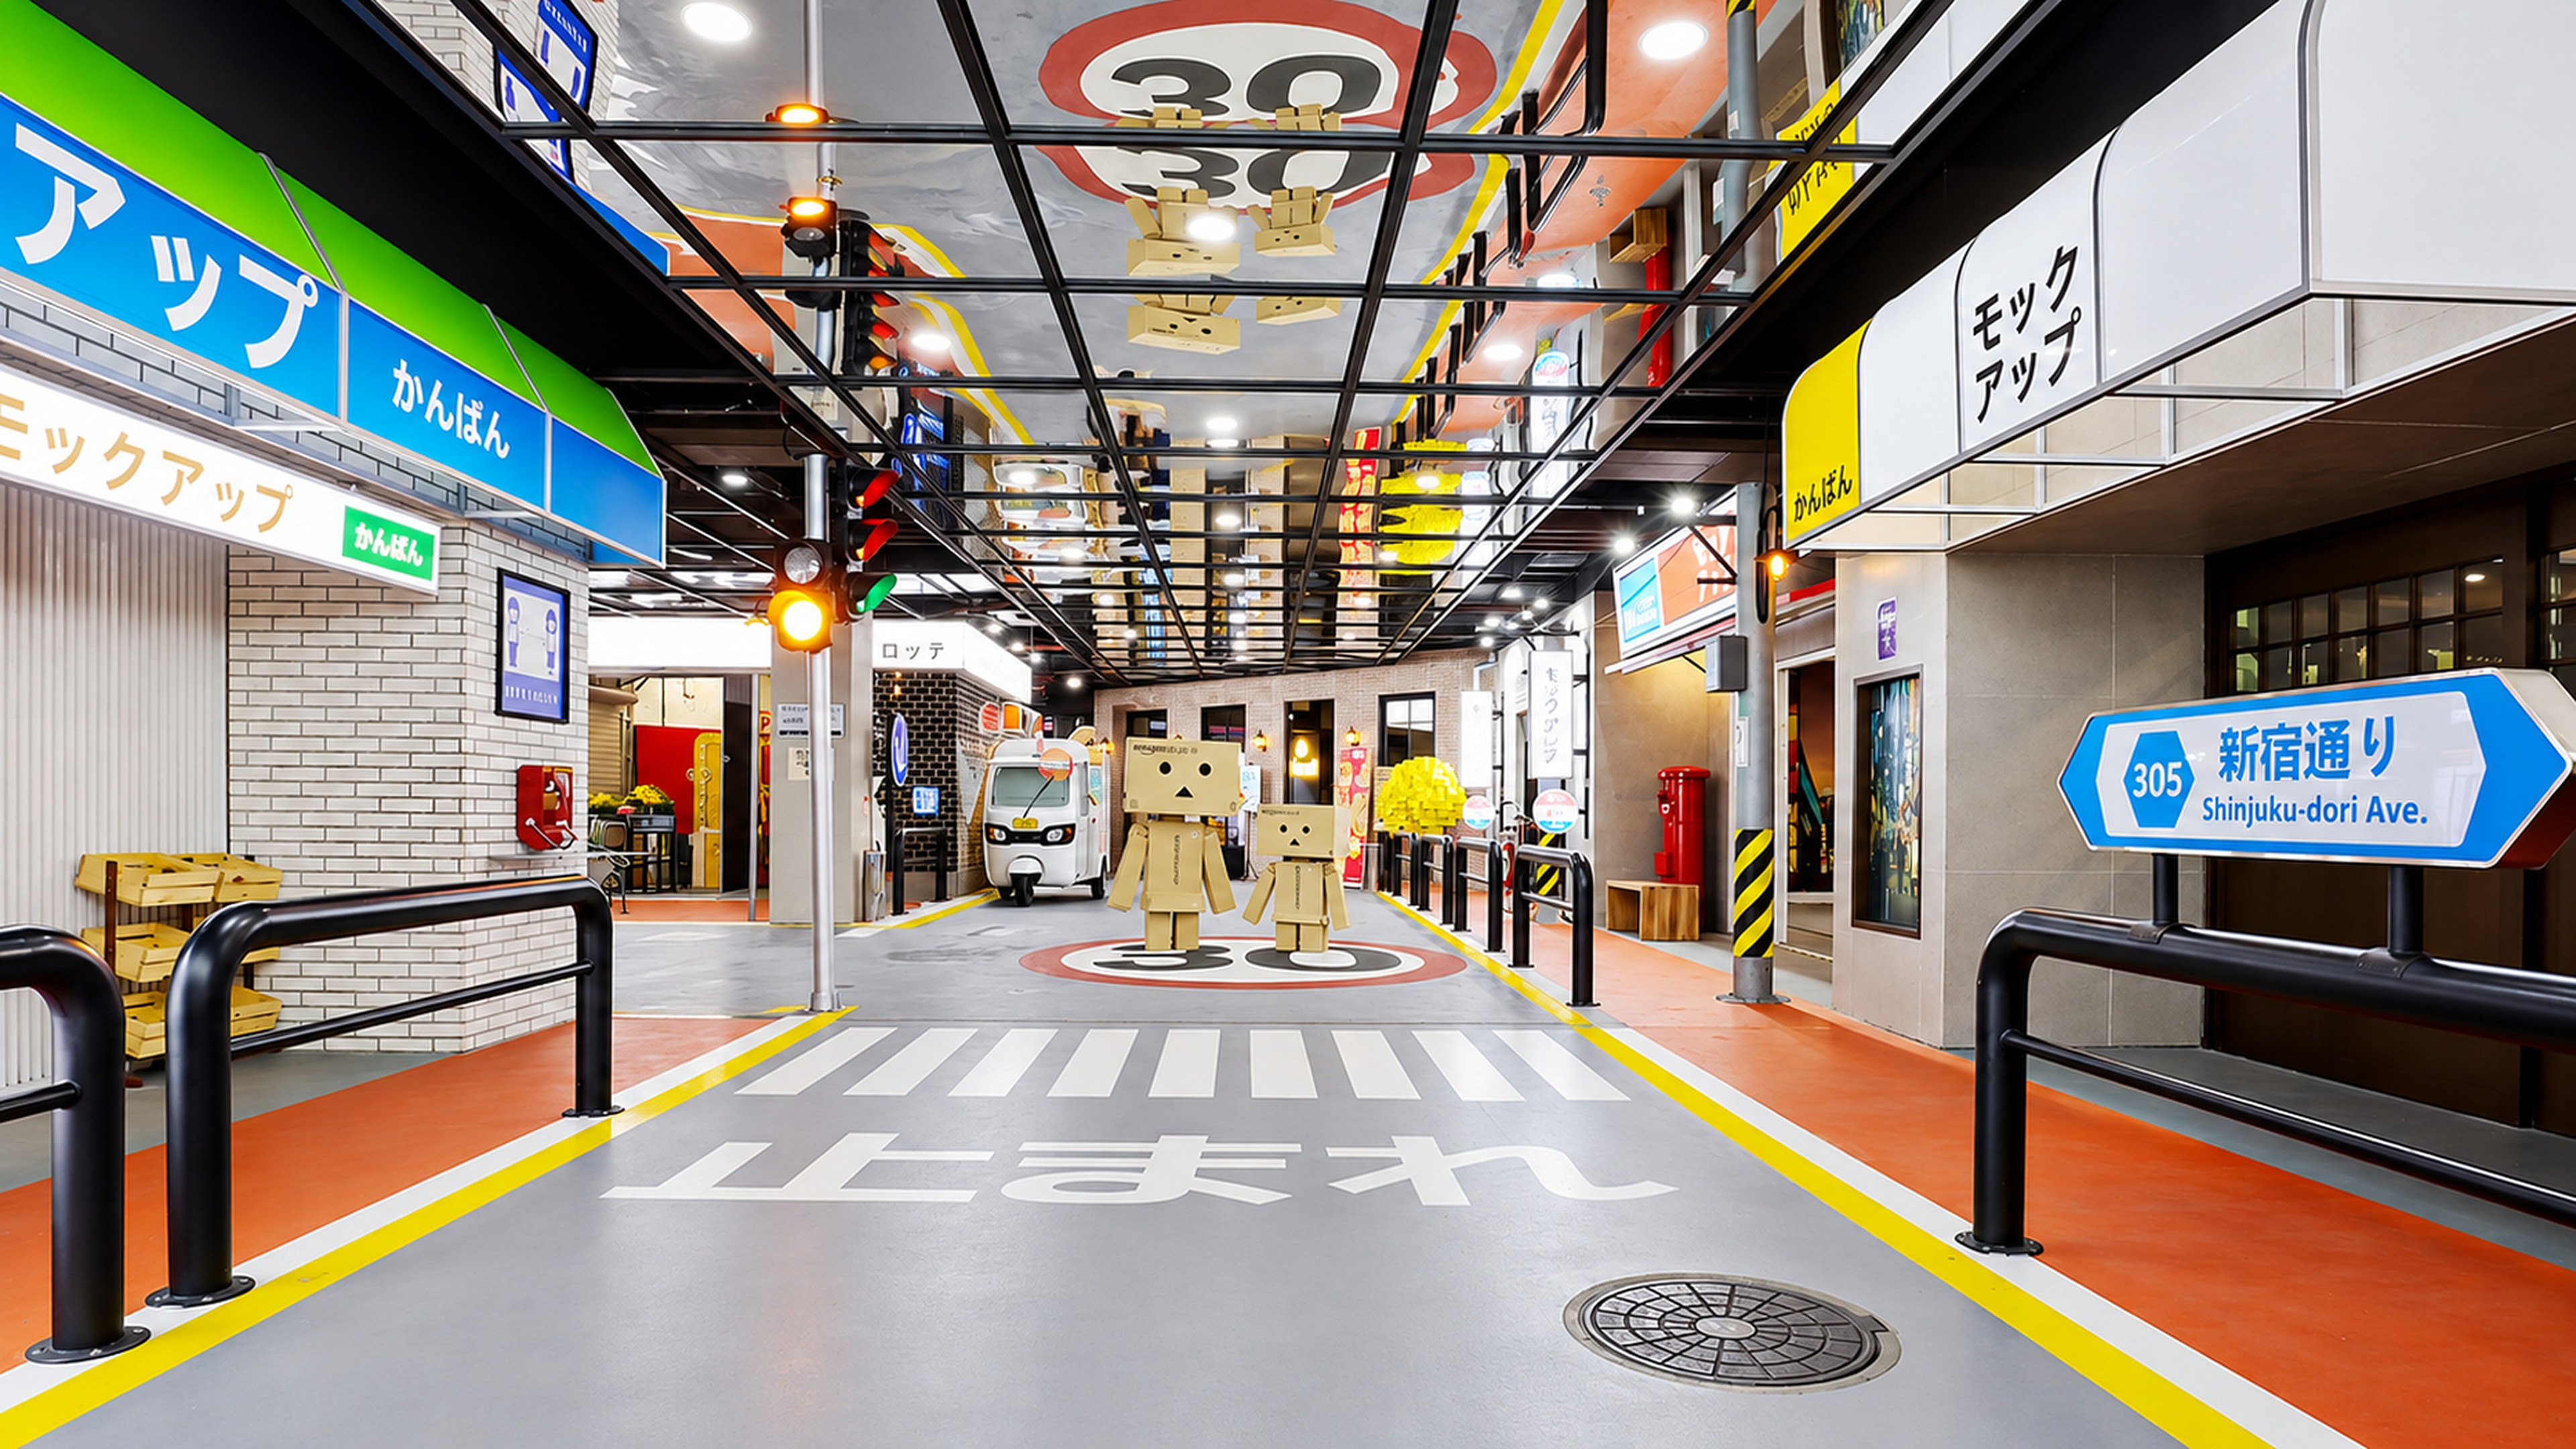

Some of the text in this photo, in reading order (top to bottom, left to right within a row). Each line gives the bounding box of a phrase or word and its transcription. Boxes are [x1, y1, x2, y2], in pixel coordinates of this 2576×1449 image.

[15, 123, 318, 368] アップ
[1973, 246, 2078, 351] モック
[1975, 306, 2082, 423] アップ
[392, 358, 511, 459] かんばん
[1794, 464, 1853, 523] かんばん
[883, 642, 944, 660] ロッテ
[2133, 761, 2182, 798] 305
[2218, 716, 2395, 782] 新宿通り
[2202, 794, 2428, 828] Shinjuku-dori Ave.
[1093, 944, 1402, 972] 30
[599, 1132, 1679, 1205] 止まれ
